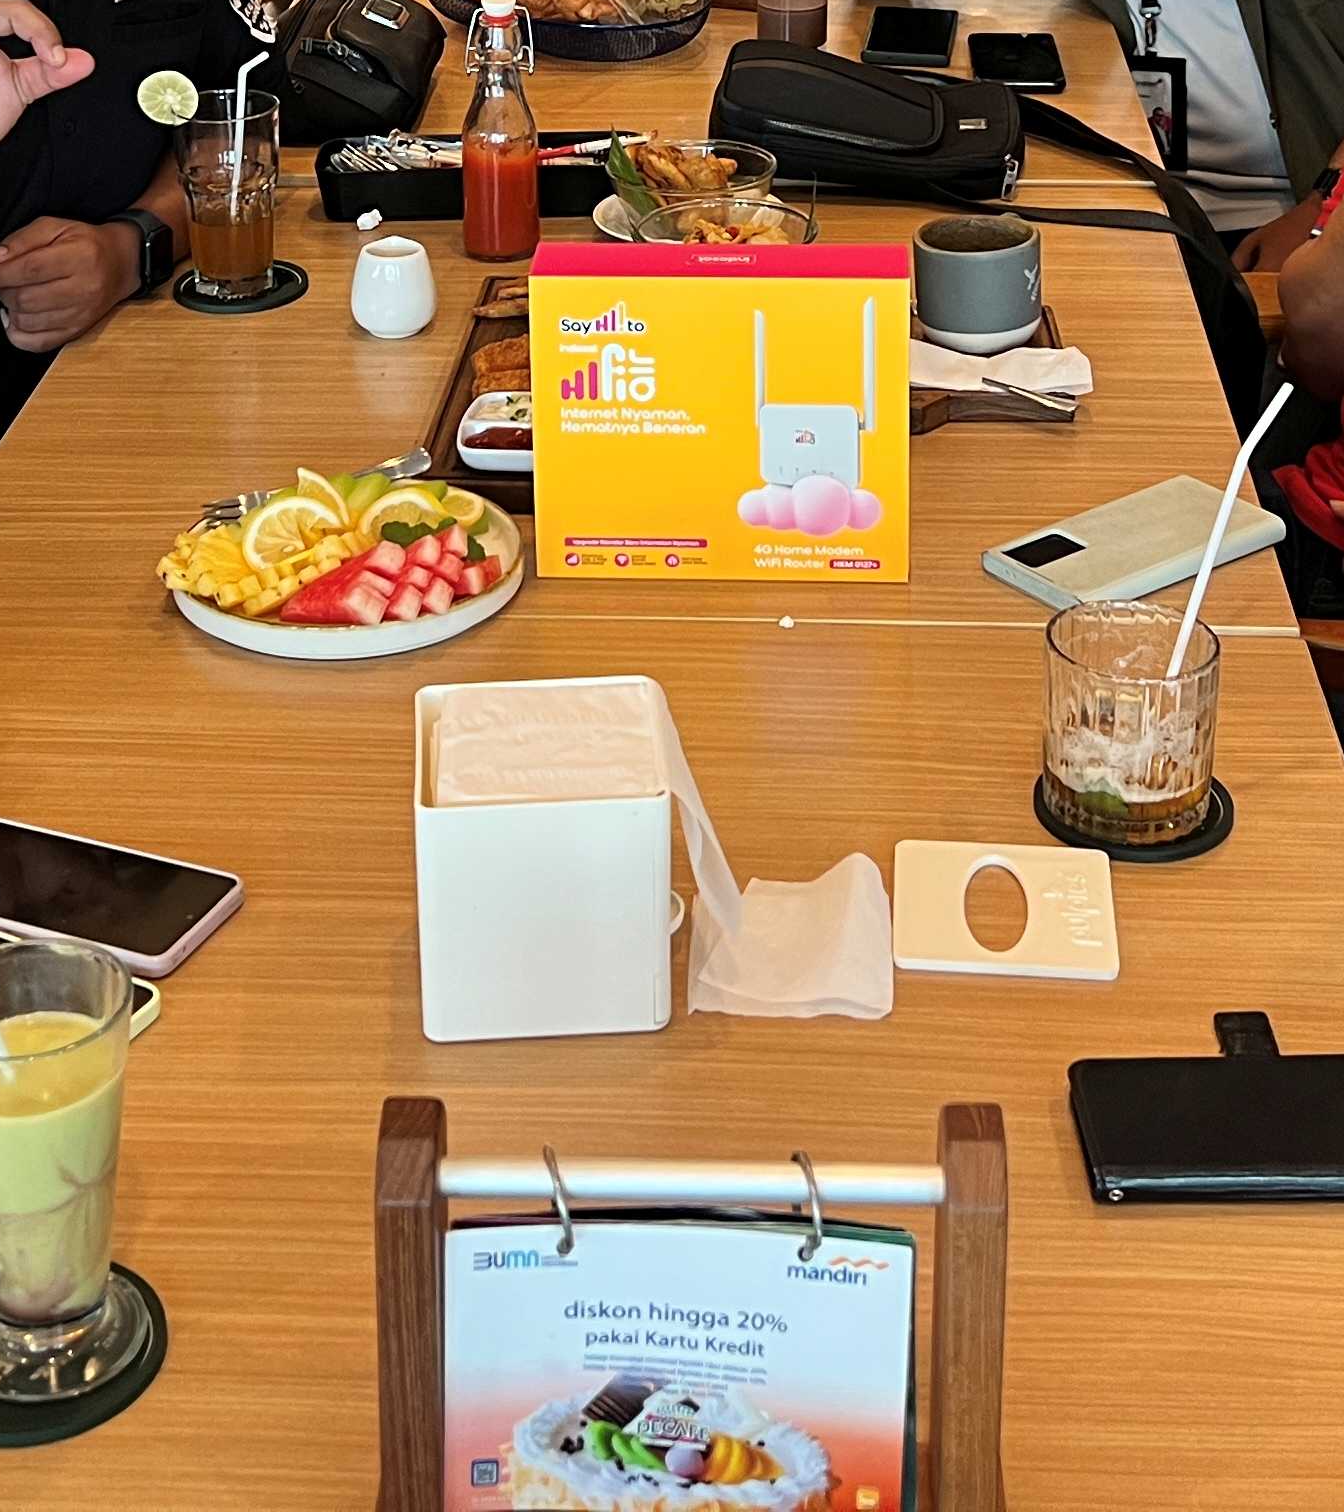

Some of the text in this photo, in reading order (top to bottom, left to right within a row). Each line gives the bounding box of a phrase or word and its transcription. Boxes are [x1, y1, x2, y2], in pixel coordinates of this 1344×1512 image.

[561, 319, 592, 334] Say
[627, 320, 645, 332] to
[560, 407, 616, 419] Internet
[643, 422, 706, 434] Beneran
[773, 545, 813, 555] Home
[814, 545, 864, 556] Modem
[783, 558, 825, 569] Router
[786, 1264, 868, 1287] mandiri
[564, 1300, 789, 1334] diskon hingga 20%
[584, 1329, 766, 1358] pakai Kartu Kredit
